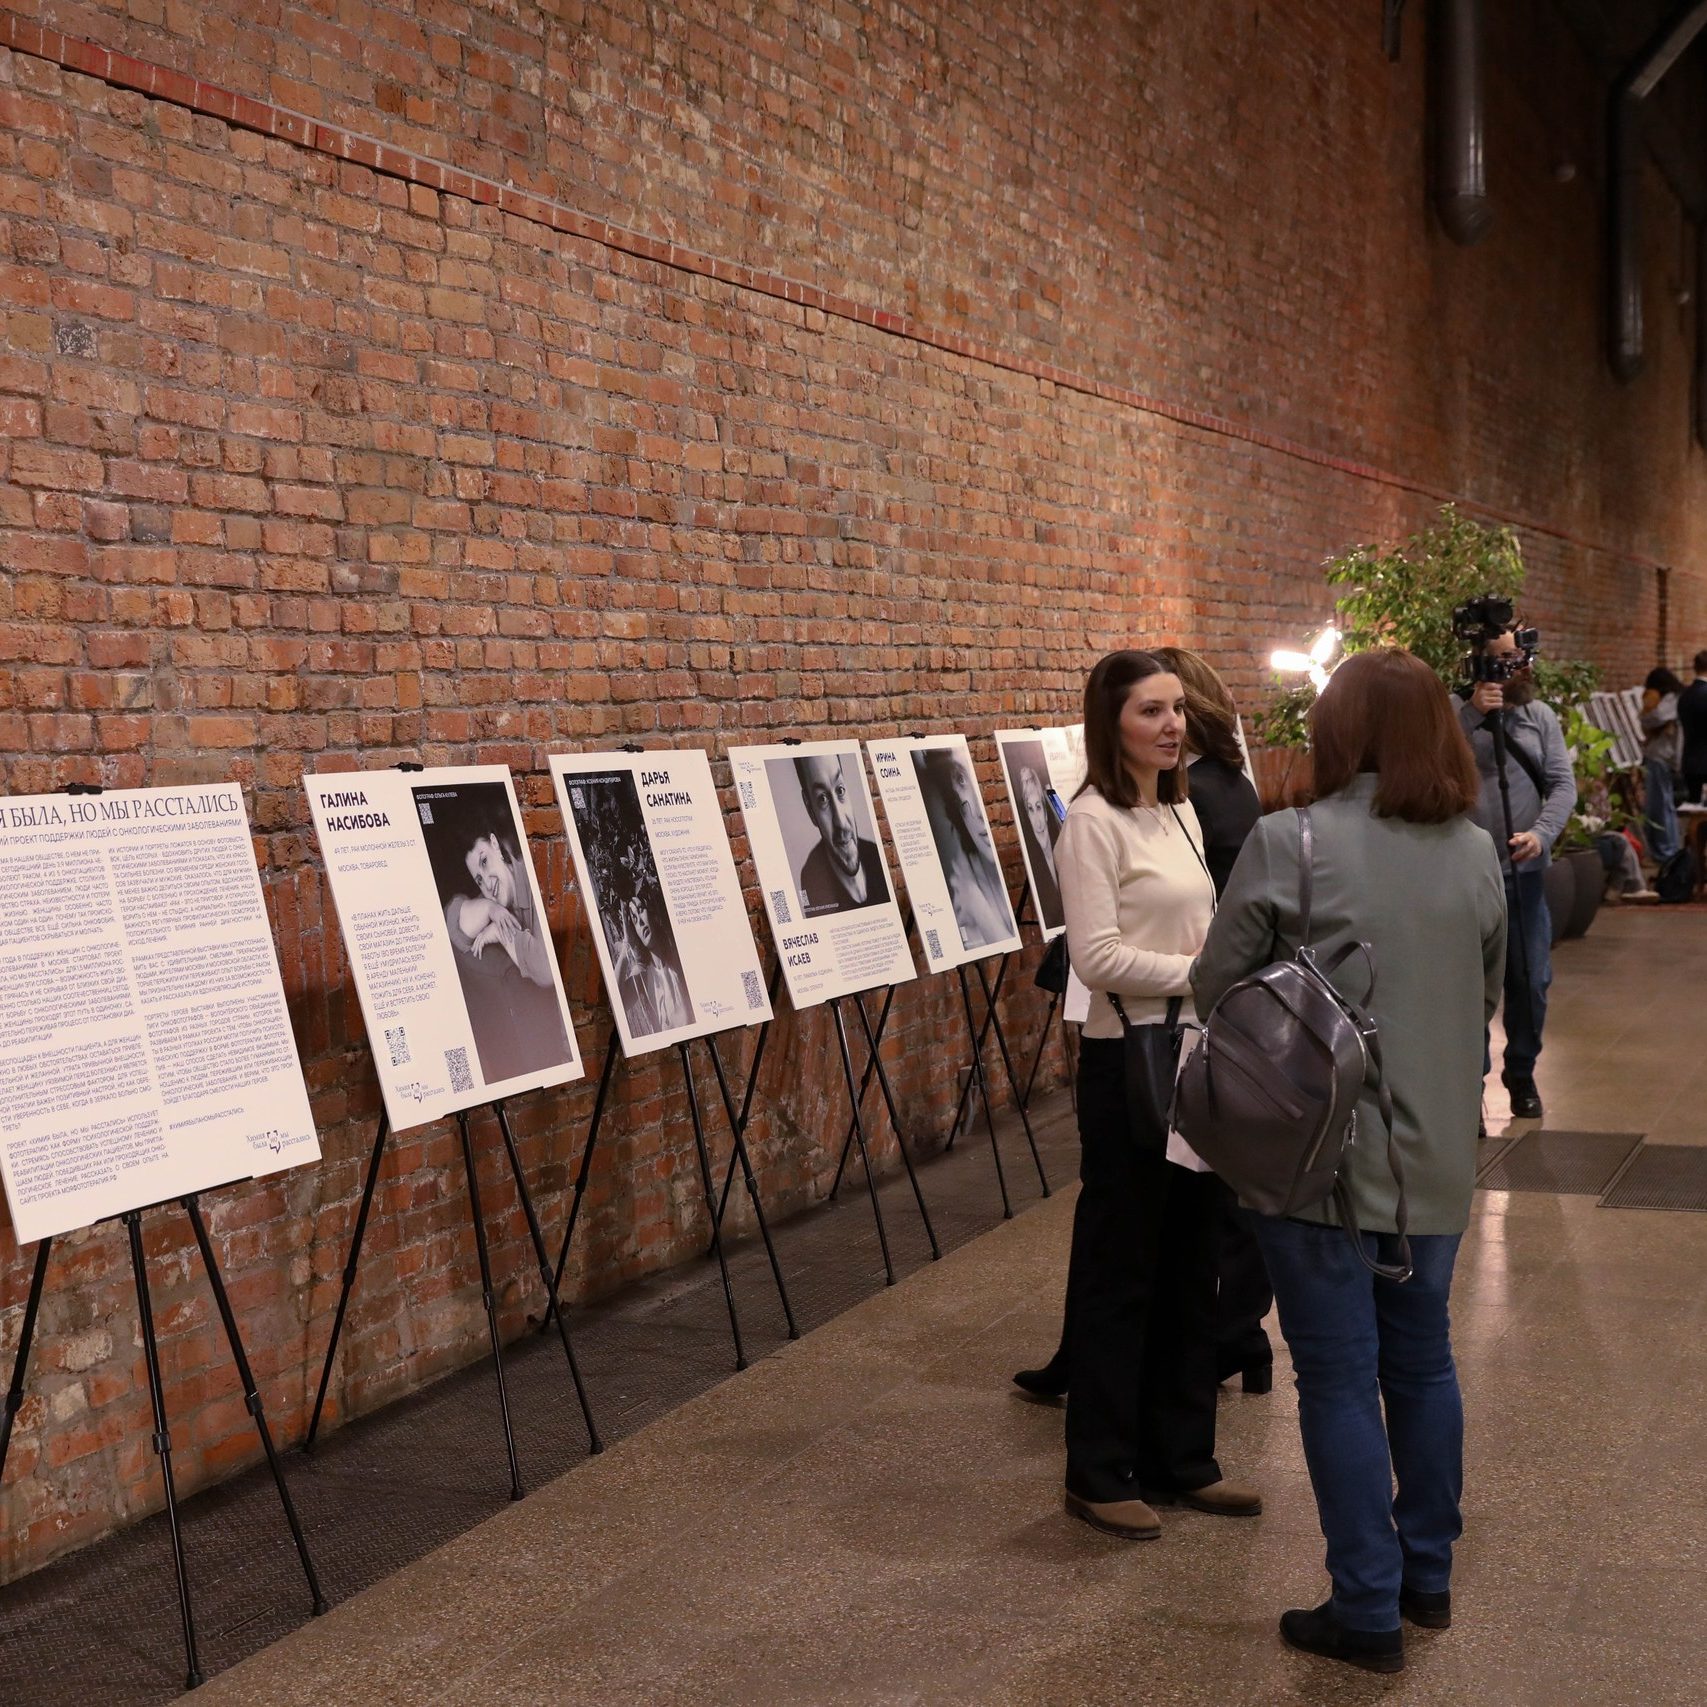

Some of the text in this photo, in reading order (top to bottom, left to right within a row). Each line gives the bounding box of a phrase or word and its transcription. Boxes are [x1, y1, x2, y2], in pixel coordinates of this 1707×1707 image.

[875, 752, 897, 763] ИРИНА
[641, 771, 670, 787] ДАРЬЯ
[880, 767, 901, 778] СОИНА
[320, 791, 368, 809] ГАЛИНА
[647, 792, 692, 807] САНАТИНА
[9, 805, 66, 828] БЫЛА,
[68, 802, 97, 823] НО
[99, 800, 130, 821] МЫ
[131, 793, 238, 818] РАССТАЛИСЬ
[326, 812, 391, 832] НАСИБОВА
[10, 819, 242, 845] ПРОЕКТ ПОДДЕРЖКИ ЛЮДЕЙ С ОНКОЛОГИЧЕСКИМИ ЗАБОЛЕВАНИЯМИ
[782, 932, 819, 950] ВЯЧЕСЛАВ
[787, 952, 811, 967] ИСАЕВ
